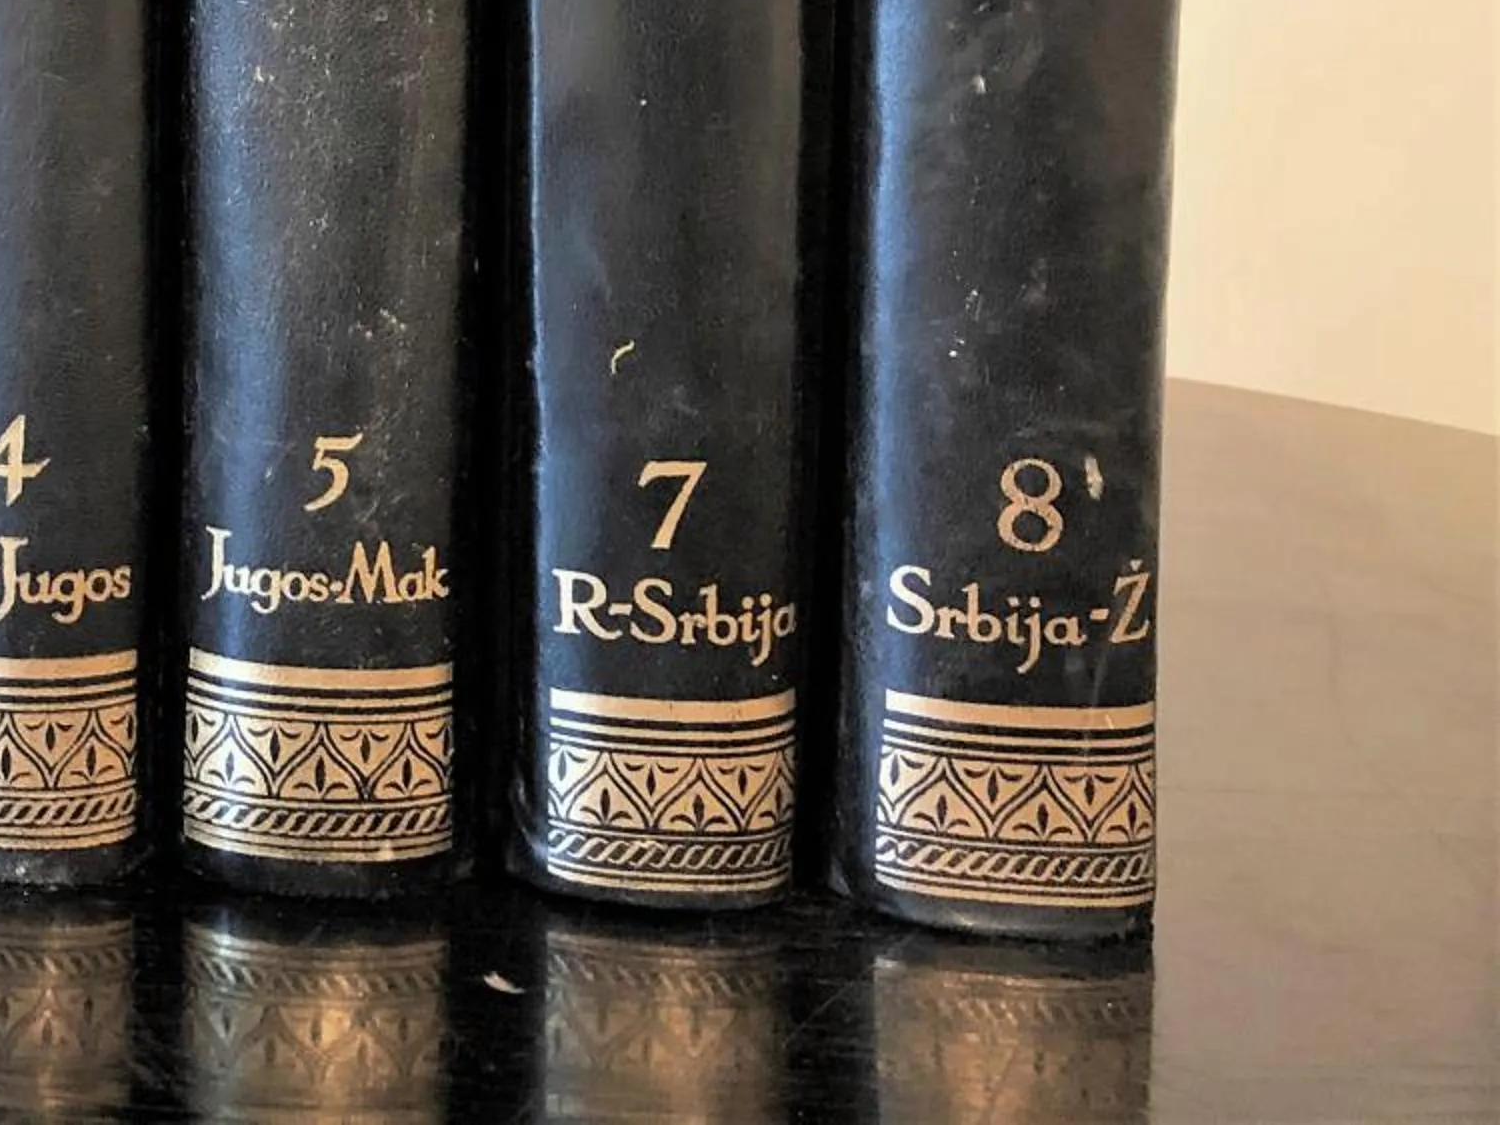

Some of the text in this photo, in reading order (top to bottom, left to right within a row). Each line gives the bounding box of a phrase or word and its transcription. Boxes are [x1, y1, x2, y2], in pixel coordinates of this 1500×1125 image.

[304, 433, 362, 512] 5
[638, 460, 707, 549] 7
[997, 457, 1064, 552] 8
[200, 525, 449, 615] Jugos-Mak
[551, 567, 797, 666] R-Srbija
